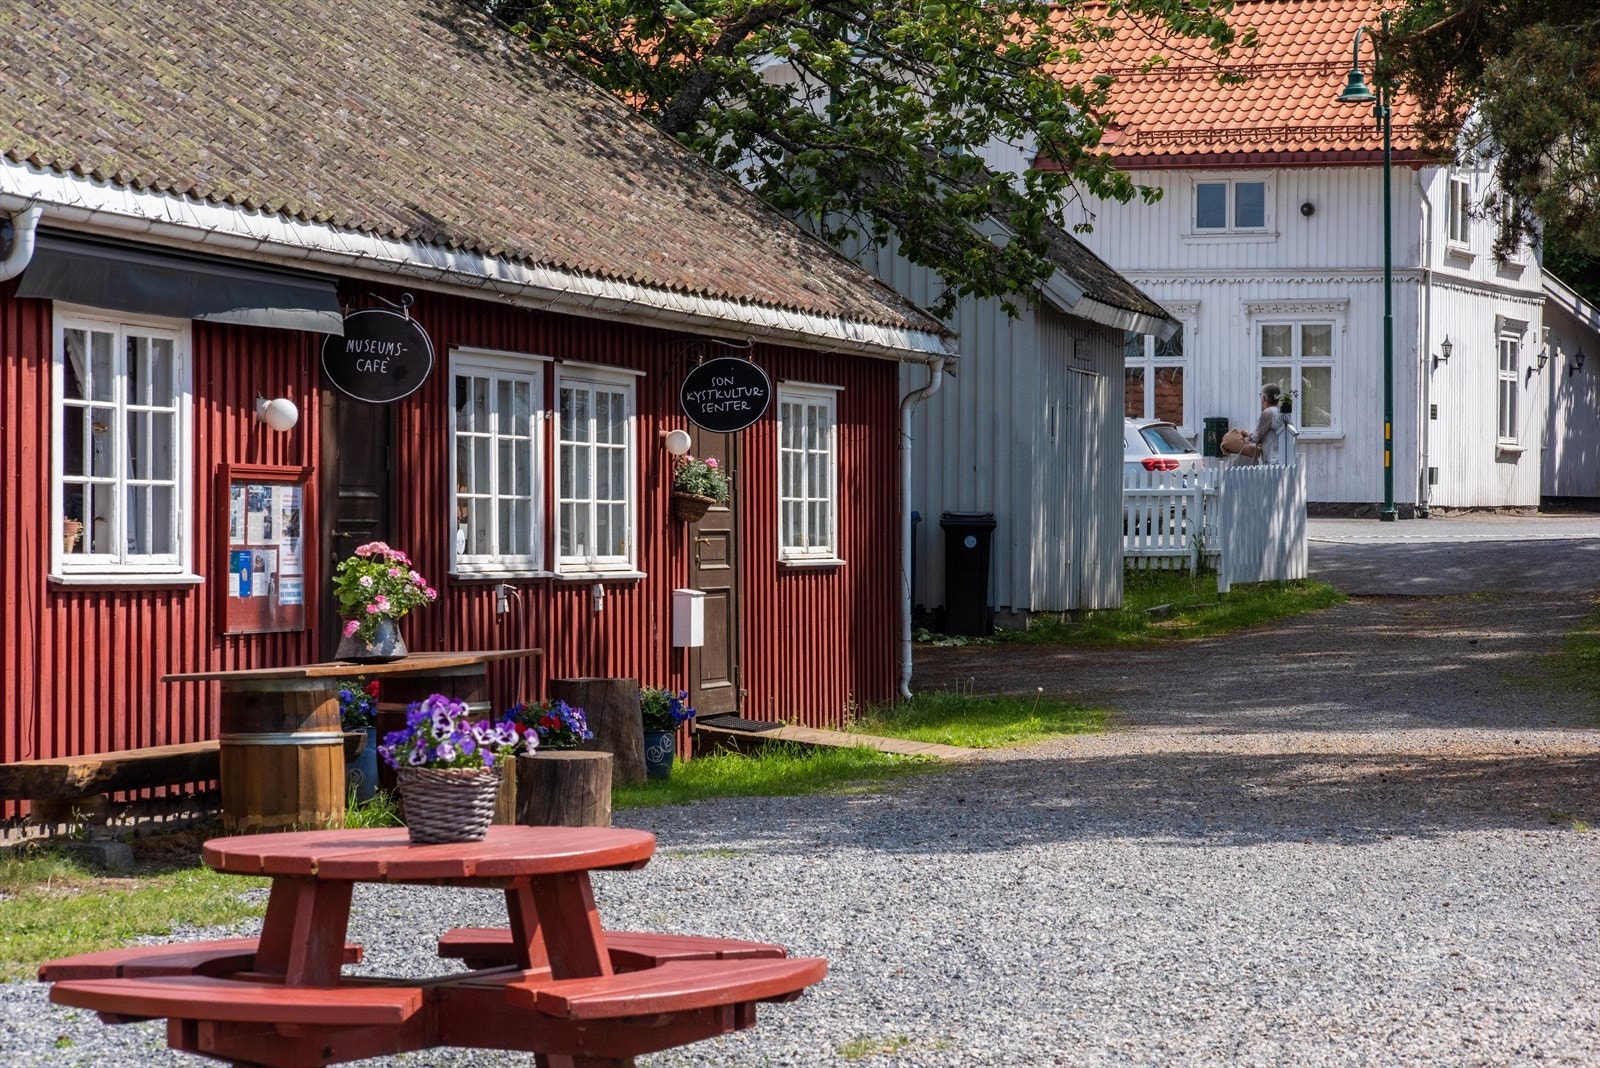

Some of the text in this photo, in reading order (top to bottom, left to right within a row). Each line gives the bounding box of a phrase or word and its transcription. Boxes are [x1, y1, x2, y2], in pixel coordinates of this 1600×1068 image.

[345, 339, 408, 356] MUSEUMS-
[711, 376, 734, 387] SON
[686, 387, 764, 403] KYSTKULTUR-
[701, 401, 751, 413] SENTER
